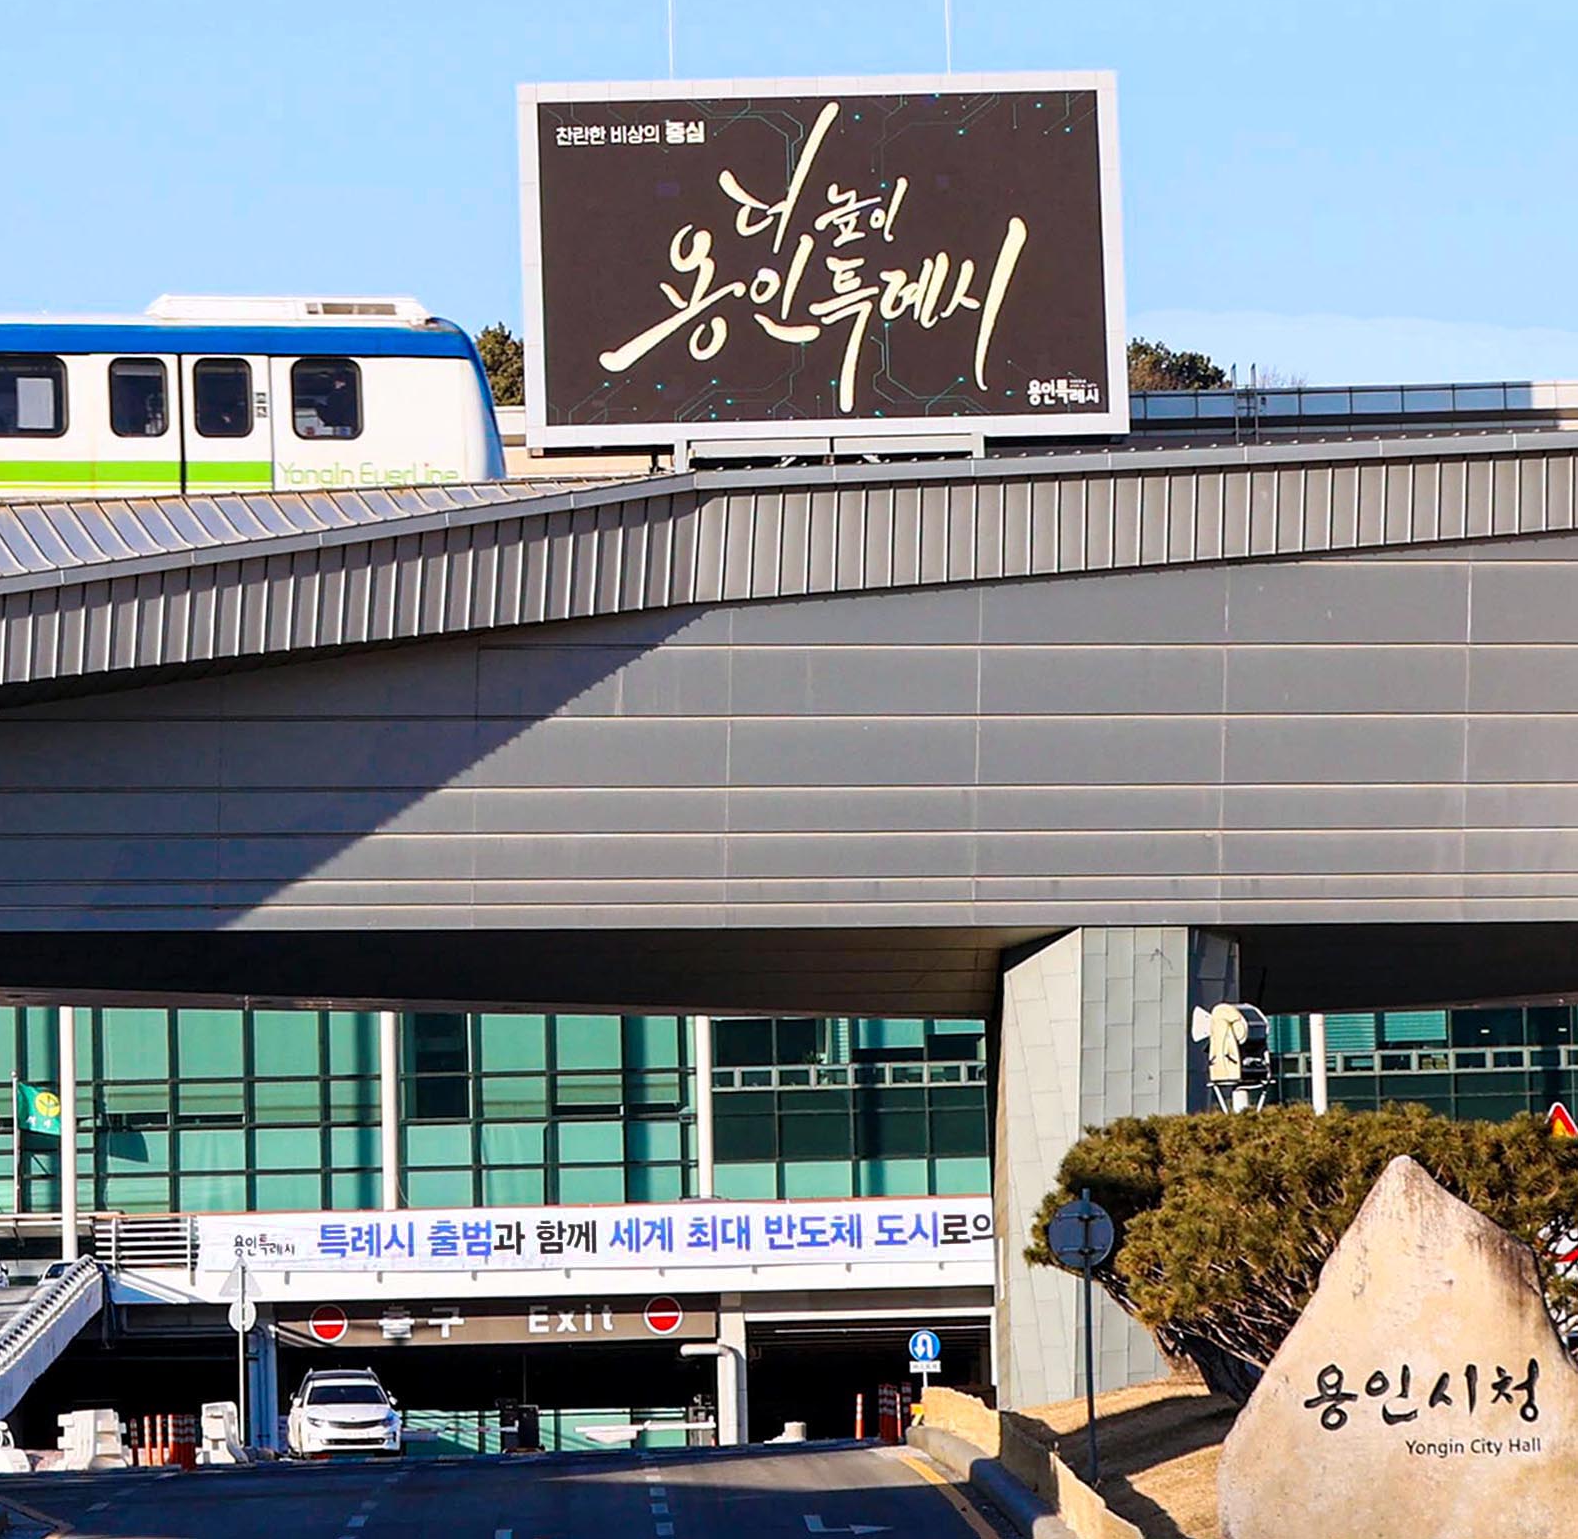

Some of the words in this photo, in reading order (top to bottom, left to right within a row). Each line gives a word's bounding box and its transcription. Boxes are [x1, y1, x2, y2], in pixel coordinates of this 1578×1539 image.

[556, 126, 606, 146] 찬란한
[610, 124, 660, 144] 비상의
[665, 120, 705, 144] 중심
[718, 101, 839, 253] 더
[814, 176, 908, 247] 높이
[599, 215, 1027, 413] 용인특례시
[1027, 379, 1099, 406] 용인특례시
[234, 1233, 296, 1257] 용인특례시
[317, 1222, 415, 1258] 특례시
[427, 1219, 525, 1257] 출범과
[536, 1220, 598, 1255] 함께
[609, 1216, 674, 1253] 세계
[686, 1214, 751, 1252] 최대
[764, 1213, 863, 1250] 반도체
[528, 1304, 614, 1334] Exit
[1304, 1358, 1540, 1431] 용인시청
[1405, 1439, 1464, 1458] Yongin
[1470, 1438, 1503, 1456] City
[1509, 1438, 1541, 1453] Hall
